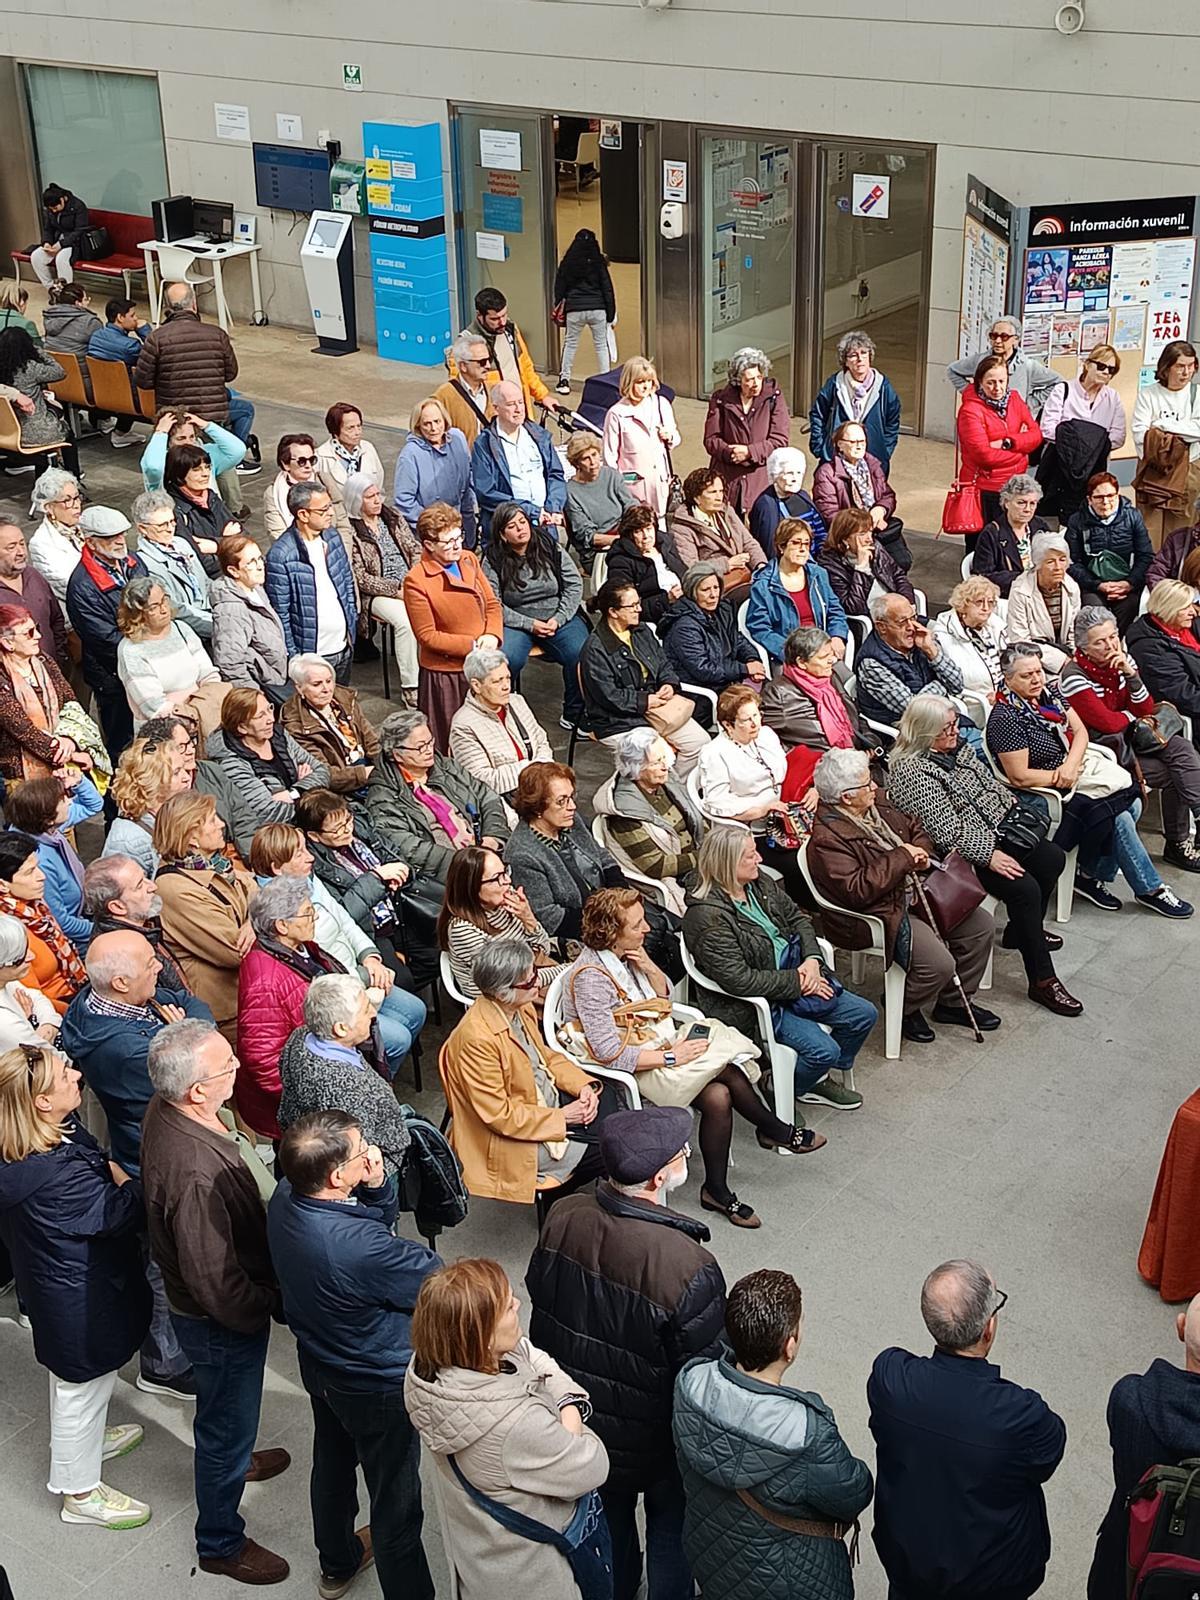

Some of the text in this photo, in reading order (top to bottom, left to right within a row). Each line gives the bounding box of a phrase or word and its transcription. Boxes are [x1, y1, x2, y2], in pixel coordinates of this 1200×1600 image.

[1070, 213, 1184, 232] Información xuvenil
[1153, 311, 1181, 325] TEA
[1152, 325, 1181, 340] TRO
